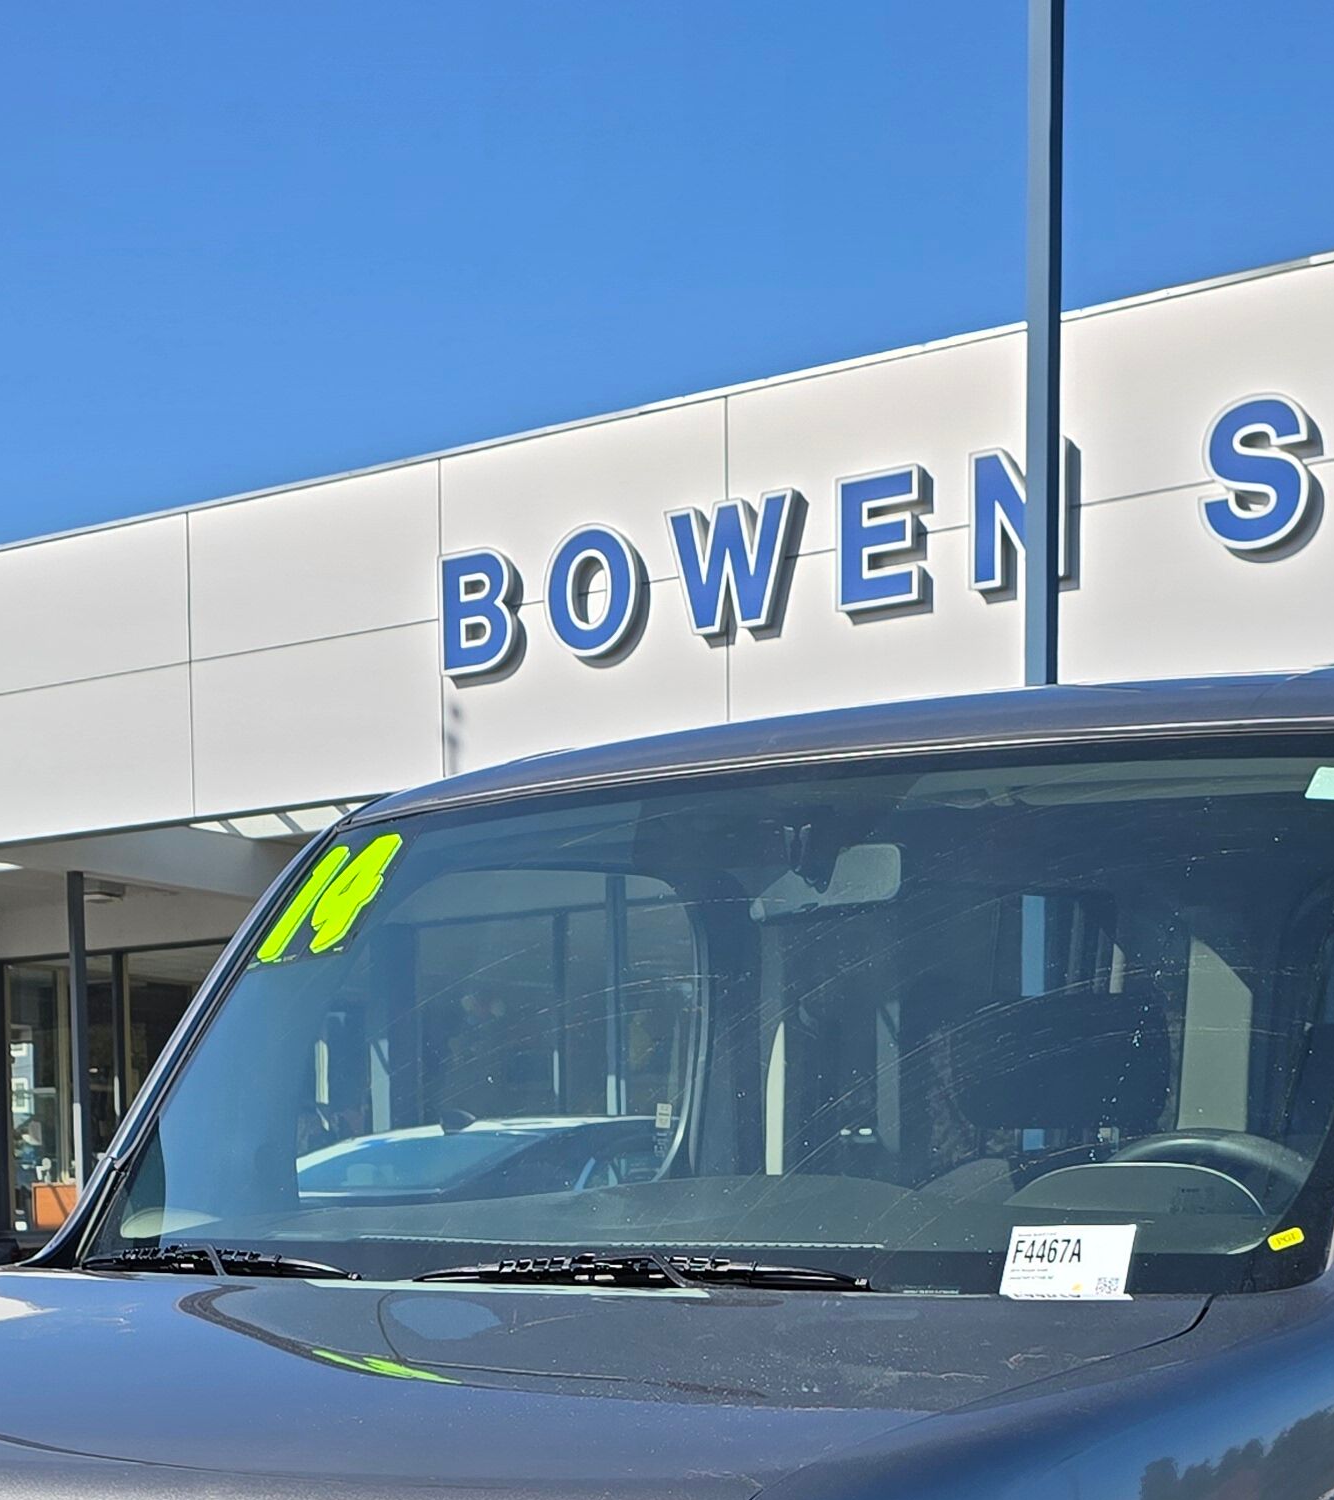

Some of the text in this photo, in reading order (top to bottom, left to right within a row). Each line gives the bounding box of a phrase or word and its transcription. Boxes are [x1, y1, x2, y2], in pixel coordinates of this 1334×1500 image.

[437, 435, 1077, 681] BOWEN
[257, 833, 403, 962] 14
[1012, 1238, 1082, 1264] F4467A
